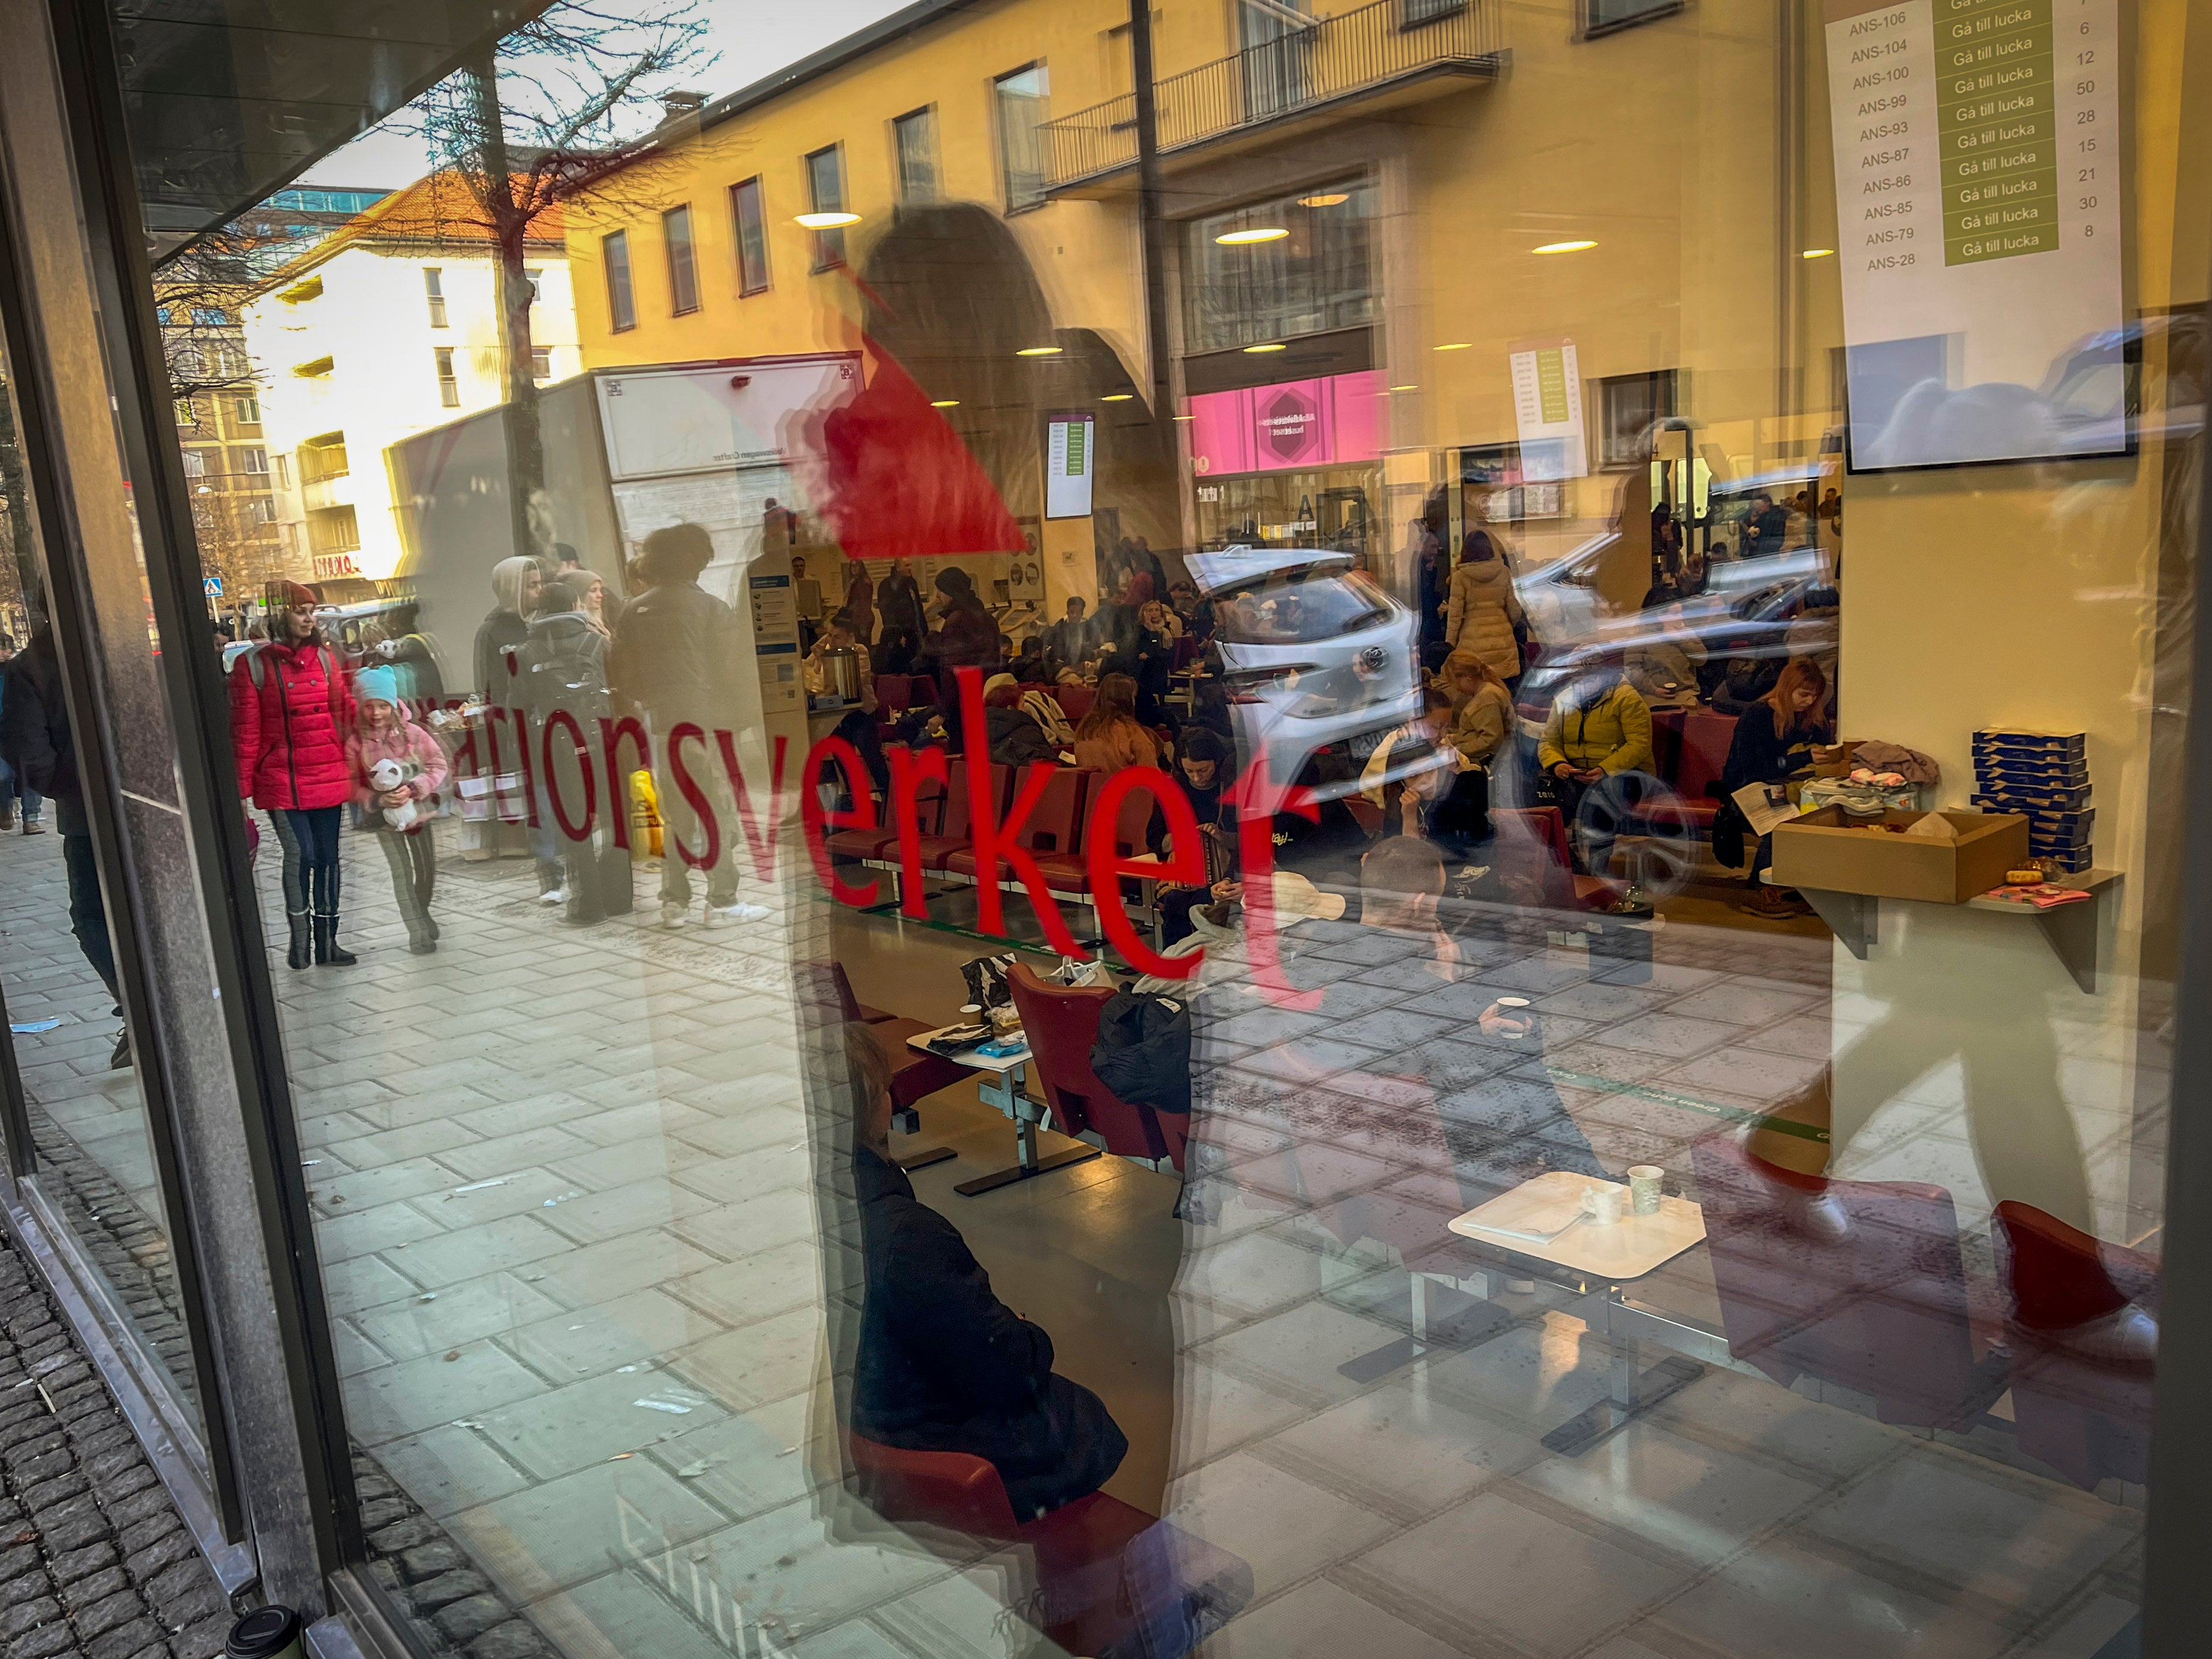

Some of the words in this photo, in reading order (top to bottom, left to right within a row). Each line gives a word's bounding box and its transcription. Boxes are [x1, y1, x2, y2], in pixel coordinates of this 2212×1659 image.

[1850, 12, 1906, 37] ANS-106
[1851, 39, 1907, 63] ANS-104
[1953, 21, 1971, 38] Gå
[1976, 17, 1990, 32] till
[1995, 10, 2032, 27] lucka
[1853, 66, 1909, 90] ANS-100
[1954, 50, 1973, 66] Gå
[1977, 46, 1991, 60] till
[1996, 39, 2032, 56] lucka
[2081, 22, 2089, 35] 6
[1858, 94, 1907, 116] ANS-99
[1955, 78, 1974, 93] Gå
[1978, 74, 1993, 89] till
[1997, 67, 2034, 85] lucka
[2076, 50, 2095, 65] 12
[1860, 121, 1909, 142] ANS-93
[1956, 106, 1976, 121] Gå
[1980, 102, 1994, 116] till
[1998, 96, 2034, 112] lucka
[2076, 80, 2095, 95] 50
[1862, 148, 1910, 168] ANS-87
[1958, 133, 1977, 148] Gå
[1981, 130, 1995, 144] till
[2000, 124, 2035, 140] lucka
[2078, 110, 2096, 124] 28
[1863, 175, 1912, 194] ANS-86
[1959, 160, 1978, 175] Gå
[1983, 158, 1997, 171] till
[2001, 153, 2037, 168] lucka
[2078, 138, 2096, 153] 15
[1865, 201, 1913, 220] ANS-85
[1960, 188, 1980, 202] Gå
[1984, 185, 1998, 198] till
[2002, 180, 2037, 195] lucka
[2079, 168, 2095, 182] 21
[1866, 228, 1914, 246] ANS-79
[1961, 215, 1981, 229] Gå
[1985, 212, 1999, 225] till
[2003, 208, 2038, 222] lucka
[2080, 196, 2098, 210] 30
[1867, 254, 1916, 271] ANS-28
[1963, 241, 1982, 256] Gå
[1986, 239, 2000, 252] till
[2004, 235, 2039, 249] lucka
[2085, 225, 2093, 237] 8
